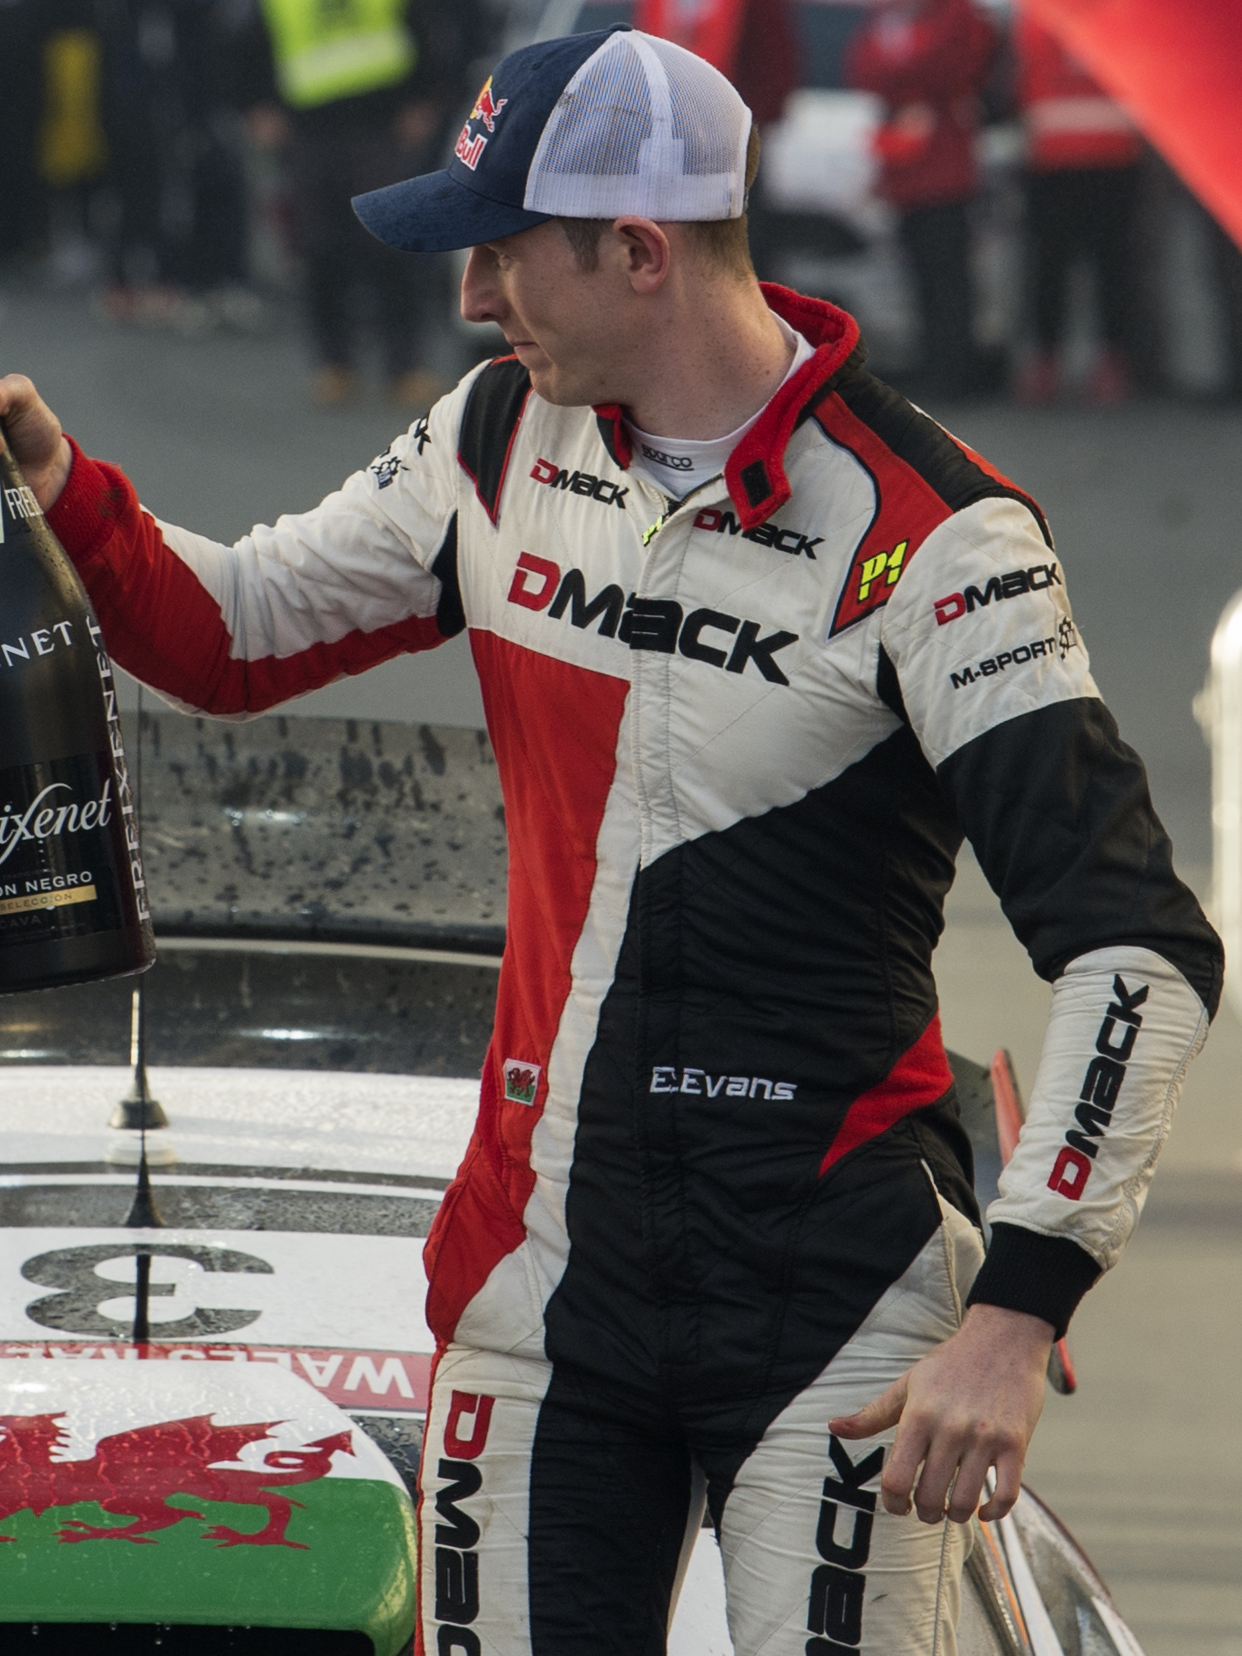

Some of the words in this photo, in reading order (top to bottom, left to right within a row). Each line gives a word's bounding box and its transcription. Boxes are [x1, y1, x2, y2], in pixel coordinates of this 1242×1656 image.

[858, 539, 910, 603] P1
[950, 637, 1056, 690] M-SPORT
[26, 871, 93, 893] NEGRO
[20, 1243, 275, 1339] 3
